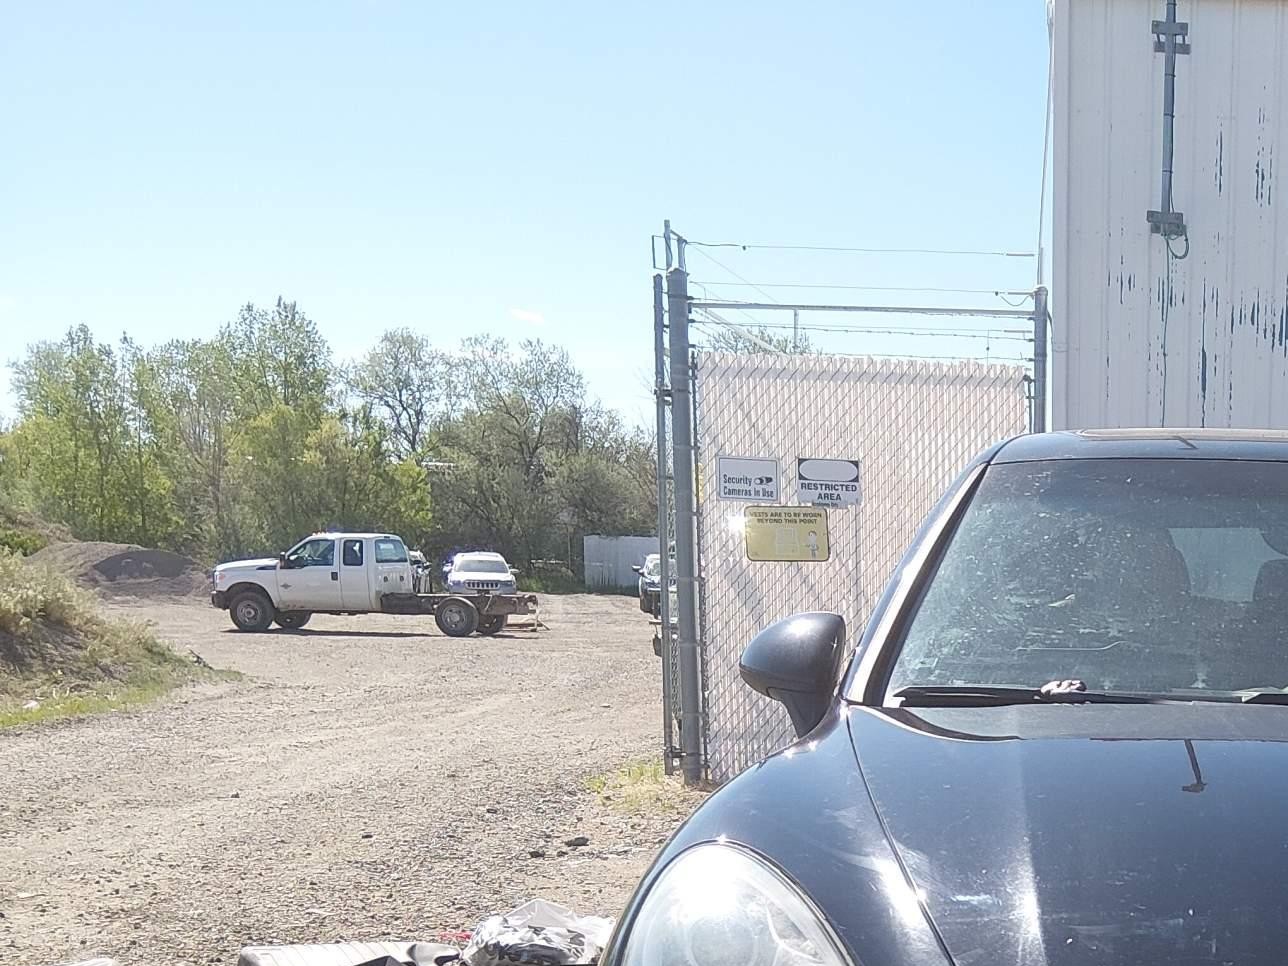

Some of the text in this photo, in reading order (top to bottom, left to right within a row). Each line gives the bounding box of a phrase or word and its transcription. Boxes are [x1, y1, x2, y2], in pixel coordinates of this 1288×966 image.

[723, 473, 752, 486] Security
[723, 486, 774, 498] Cameras In Use
[800, 482, 858, 492] RESTRICTED
[817, 492, 842, 501] AREA
